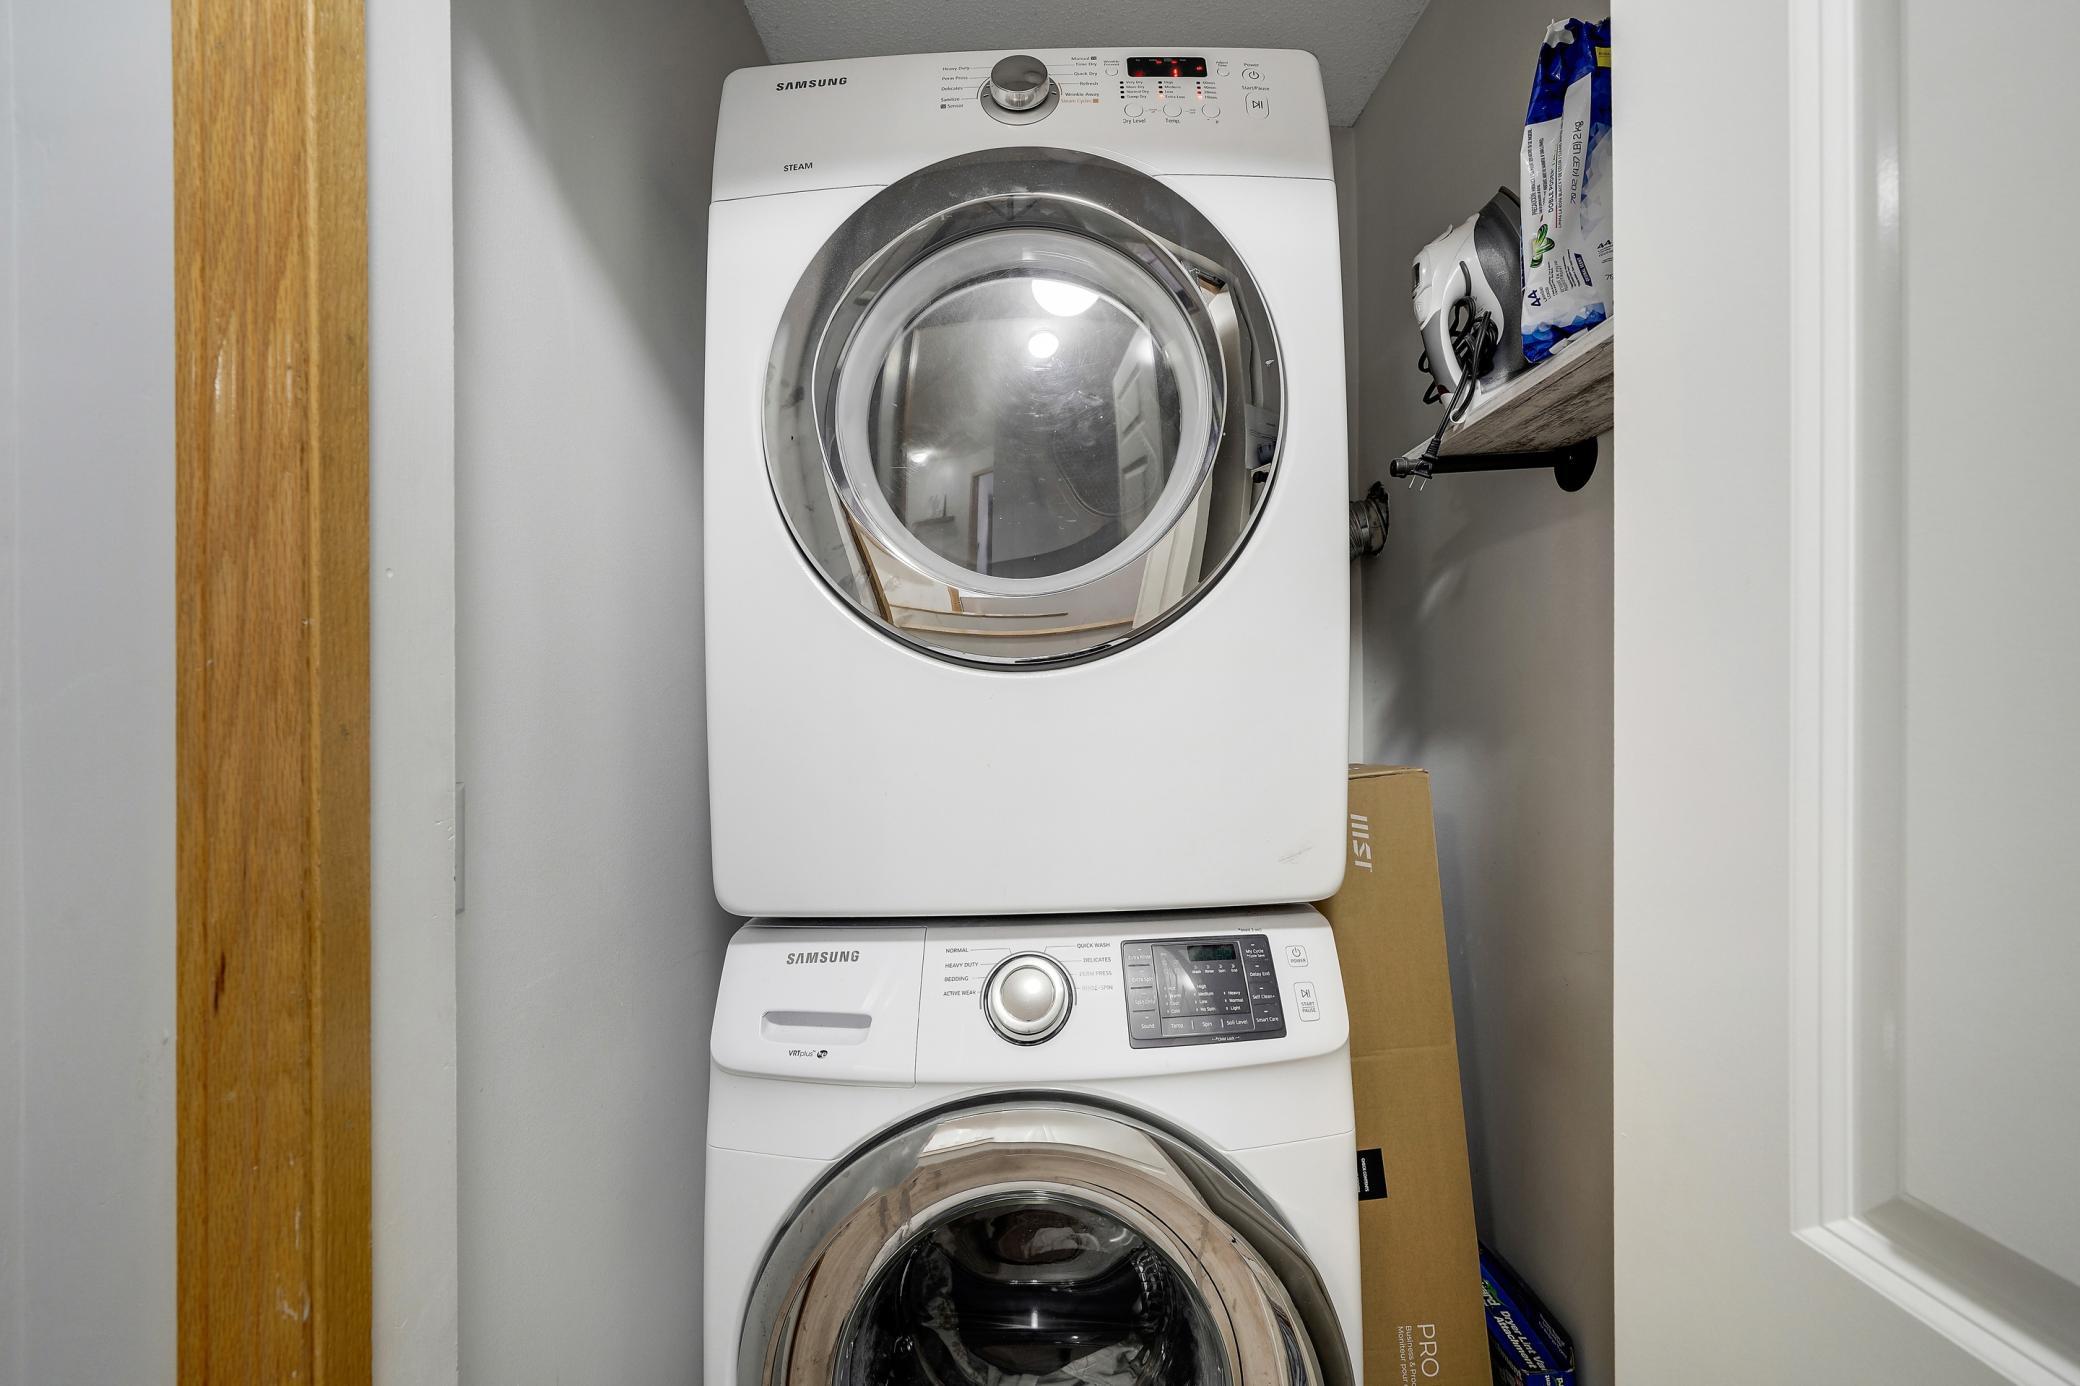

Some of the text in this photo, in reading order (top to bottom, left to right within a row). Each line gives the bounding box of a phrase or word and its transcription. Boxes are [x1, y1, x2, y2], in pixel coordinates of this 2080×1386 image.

[776, 77, 848, 91] SAMSUNG
[783, 163, 813, 172] STEAM
[1528, 290, 1541, 306] 44
[786, 951, 860, 965] SAMSUNG
[1405, 1325, 1415, 1360] Business
[1493, 1315, 1537, 1369] Attachment
[1500, 1310, 1523, 1336] Dryer
[1518, 1336, 1538, 1355] Lint
[1417, 1323, 1439, 1377] PRO
